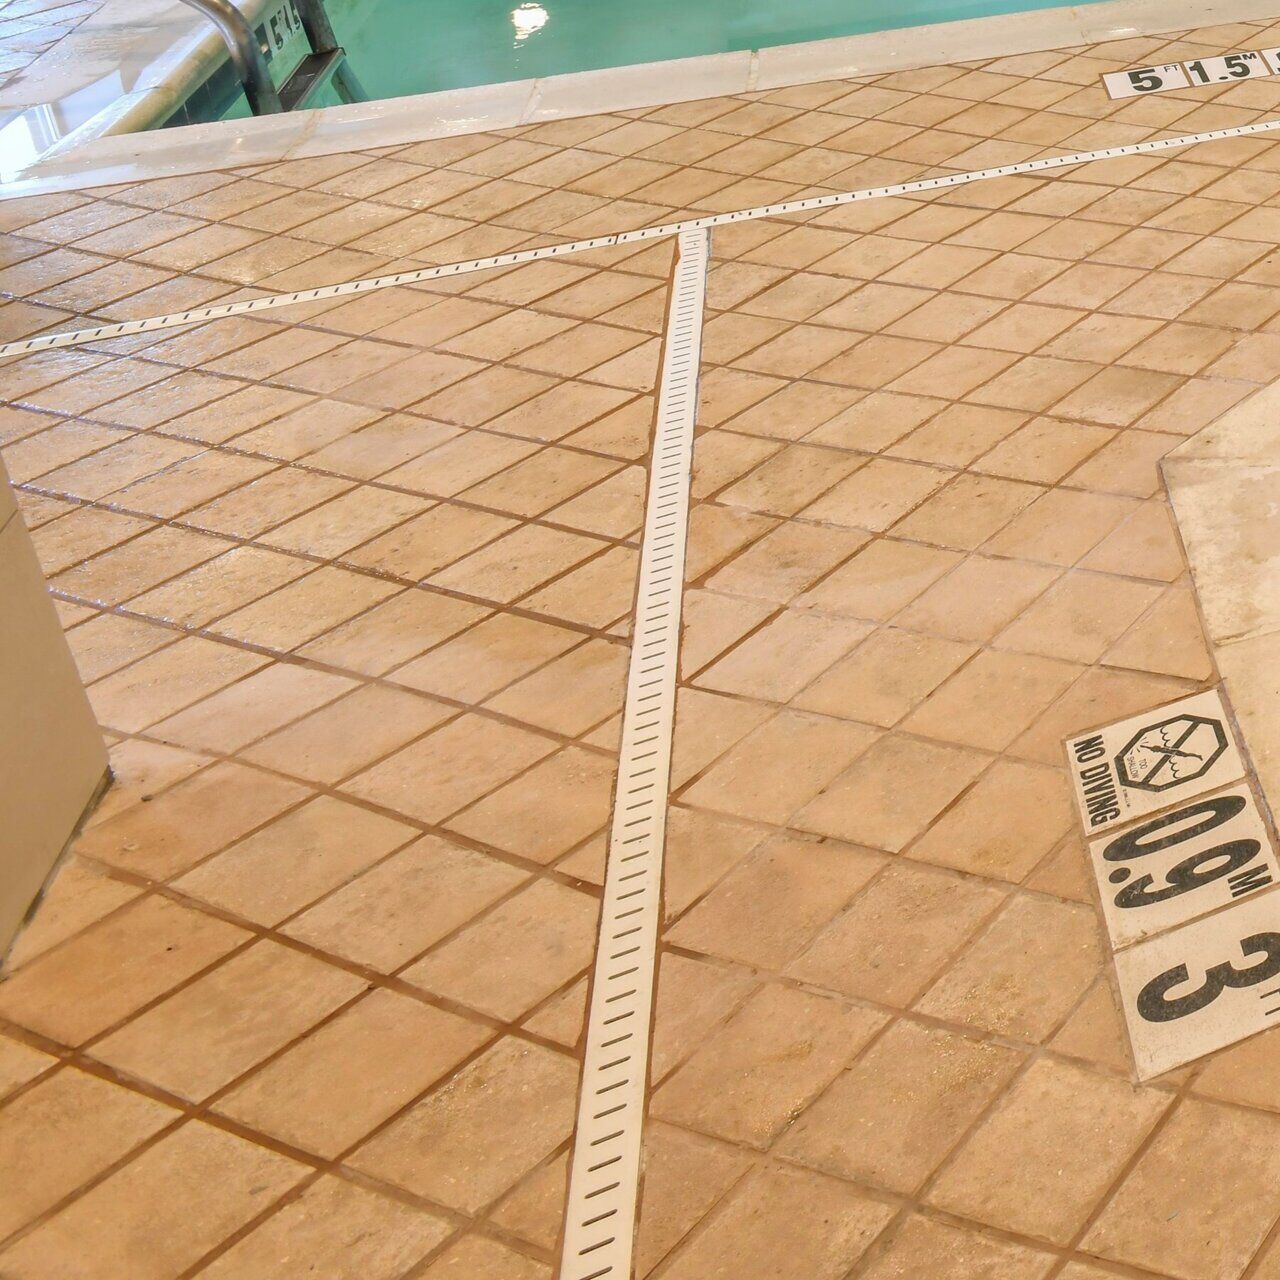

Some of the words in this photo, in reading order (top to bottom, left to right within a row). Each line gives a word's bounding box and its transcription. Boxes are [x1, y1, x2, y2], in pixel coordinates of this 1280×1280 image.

[1127, 68, 1163, 92] 5
[1073, 734, 1105, 764] NO
[1078, 761, 1122, 827] DIVING
